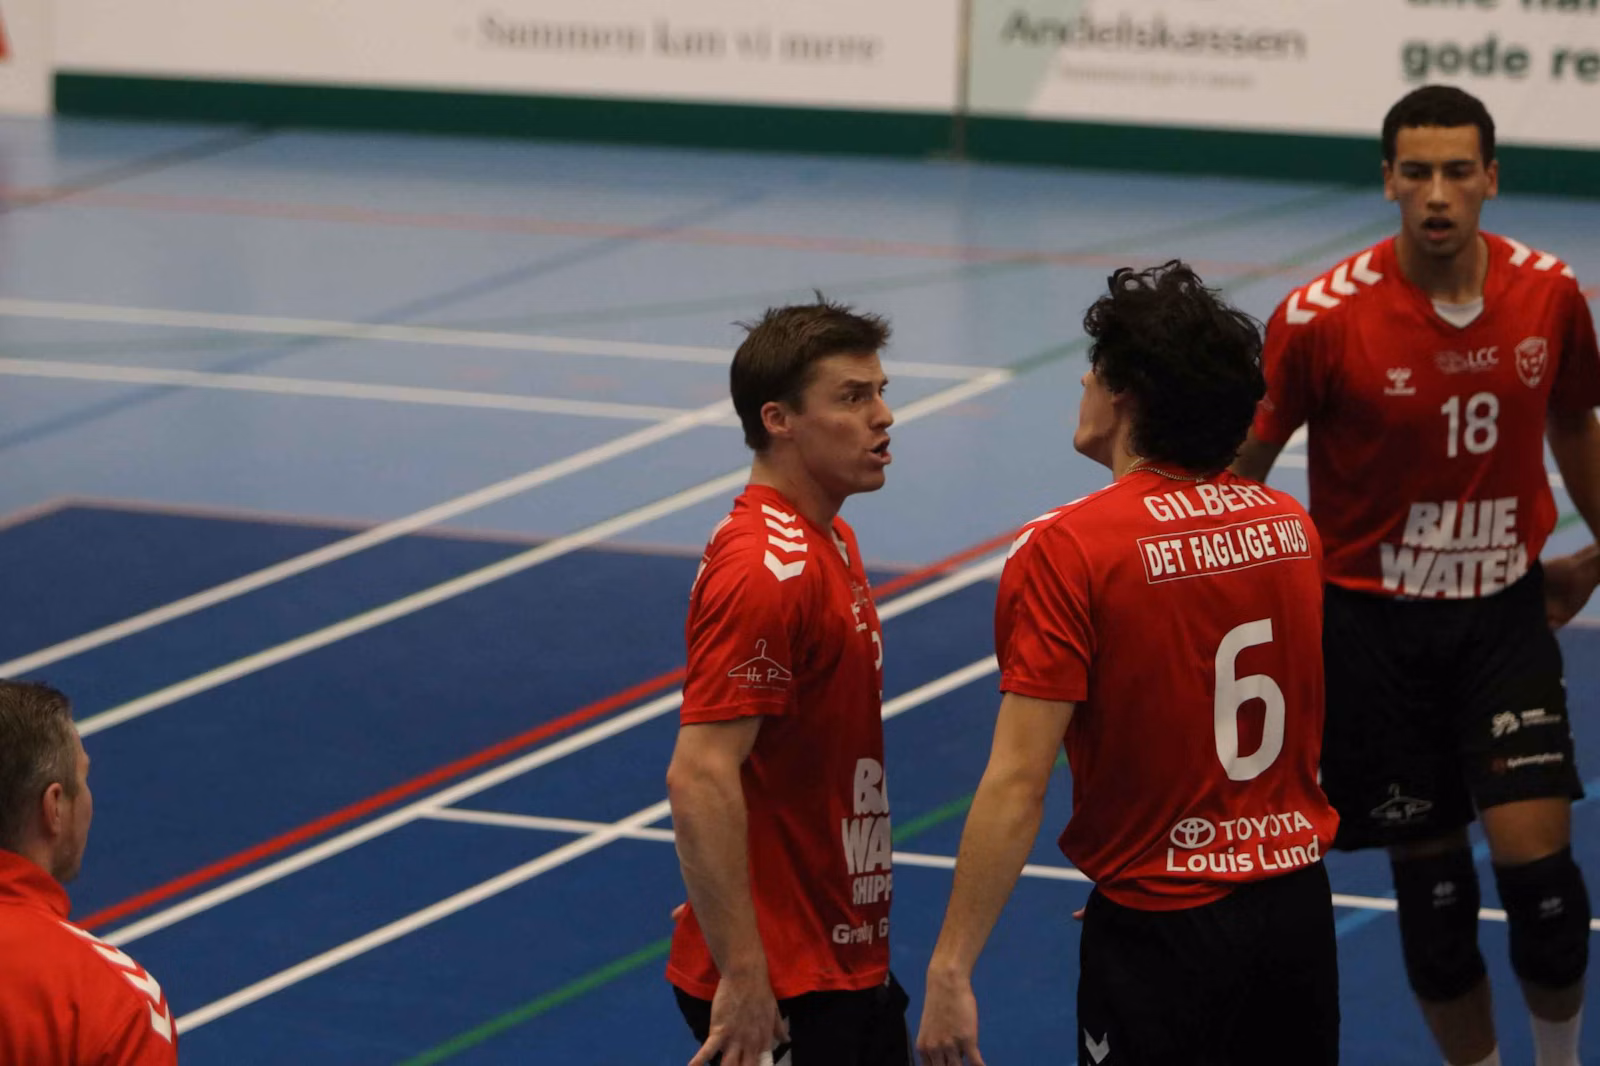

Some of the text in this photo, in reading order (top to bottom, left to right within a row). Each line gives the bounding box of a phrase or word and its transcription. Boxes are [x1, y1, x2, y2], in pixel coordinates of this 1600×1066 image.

[1402, 33, 1530, 80] gode
[1467, 345, 1499, 368] LCC
[1440, 392, 1499, 458] 18
[1143, 484, 1277, 522] GILBERT
[1402, 497, 1519, 549] BLUE
[1144, 519, 1307, 577] DET FAGLIGE HUS
[1214, 618, 1286, 781] 6
[1220, 811, 1313, 841] TOYOTA
[1166, 835, 1321, 873] Louis Lund
